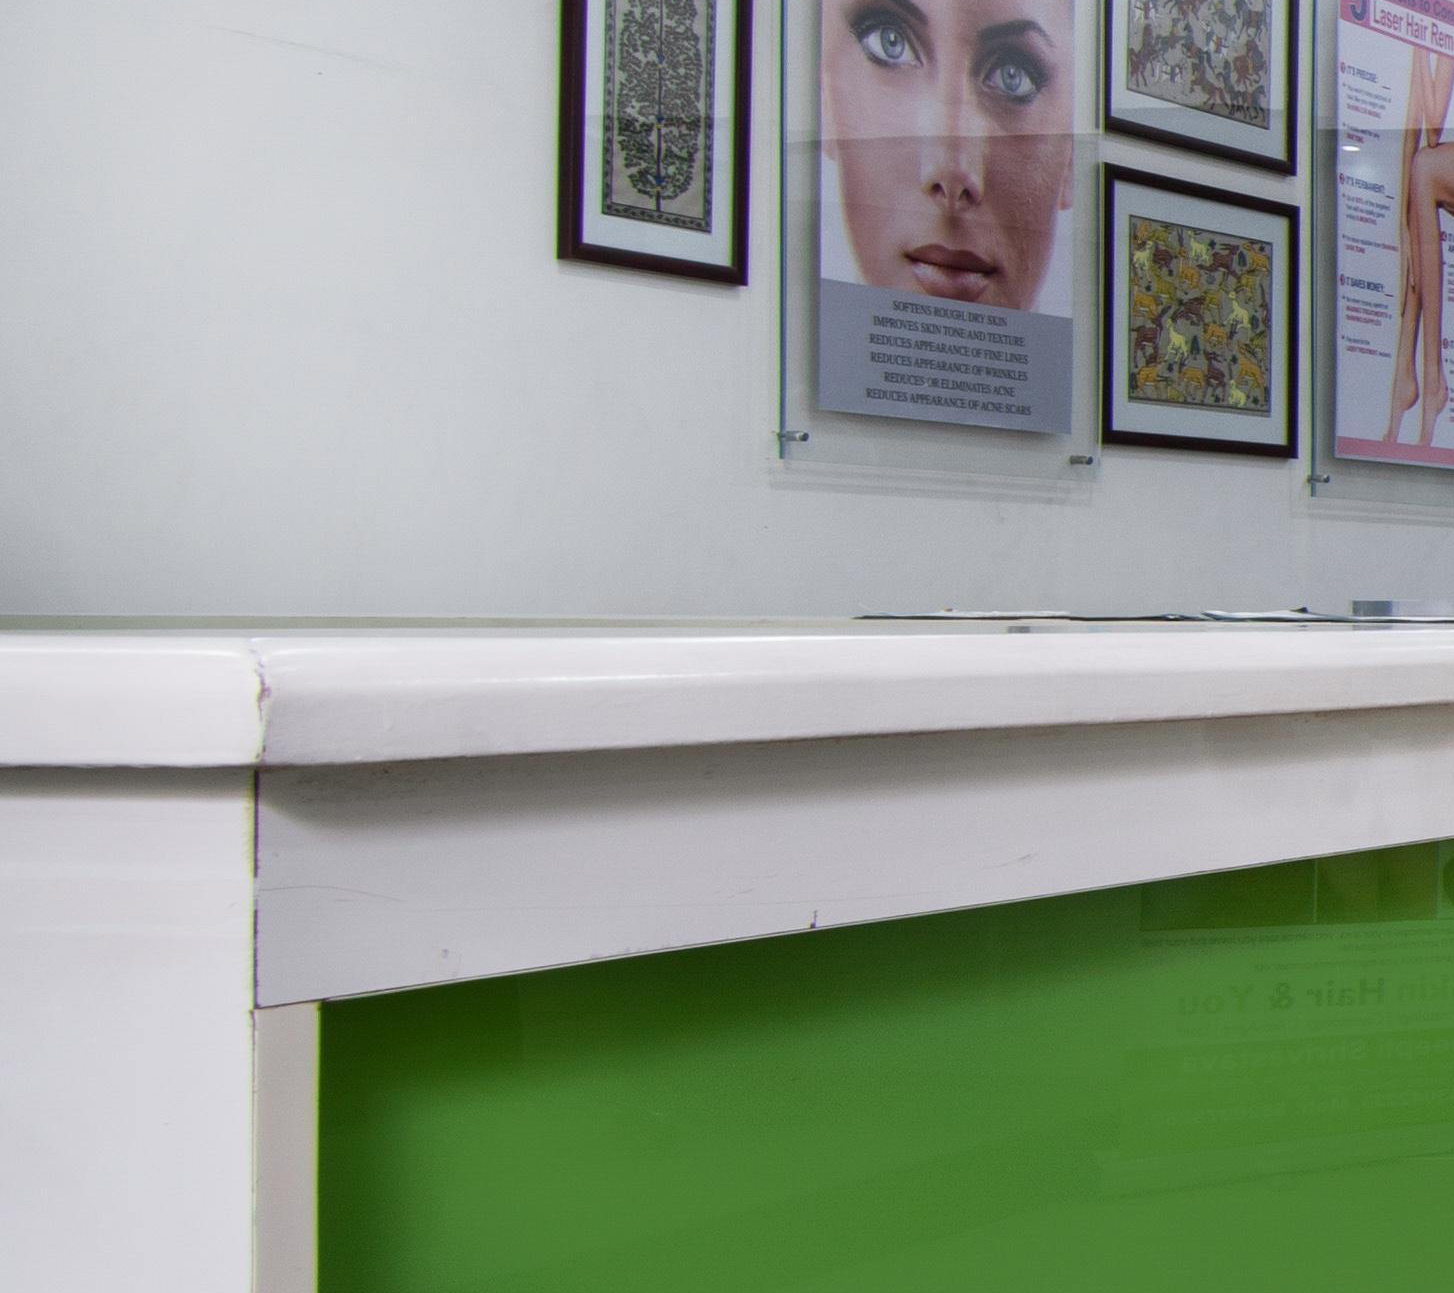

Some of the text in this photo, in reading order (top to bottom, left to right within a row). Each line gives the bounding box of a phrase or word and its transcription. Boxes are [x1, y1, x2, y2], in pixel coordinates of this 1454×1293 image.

[1372, 0, 1403, 32] Laser
[1406, 13, 1429, 41] Hair
[1351, 278, 1366, 290] SAVES
[893, 300, 932, 316] SOFTENS
[968, 312, 984, 324] DRY
[987, 314, 1008, 326] SKIN
[873, 316, 1026, 347] IMPROVES SKIN TONE AND TEXTURE
[869, 333, 1030, 364] REDUCES APPEARANCE OF FINE LINES
[870, 352, 1028, 381] REDUCES APPEARANCE OF WRINKLES
[883, 372, 1016, 398] REDUCES OR ELIMINATES ACNE
[866, 388, 1032, 416] REDUCES APPEARANCE OF ACNE SCARS
